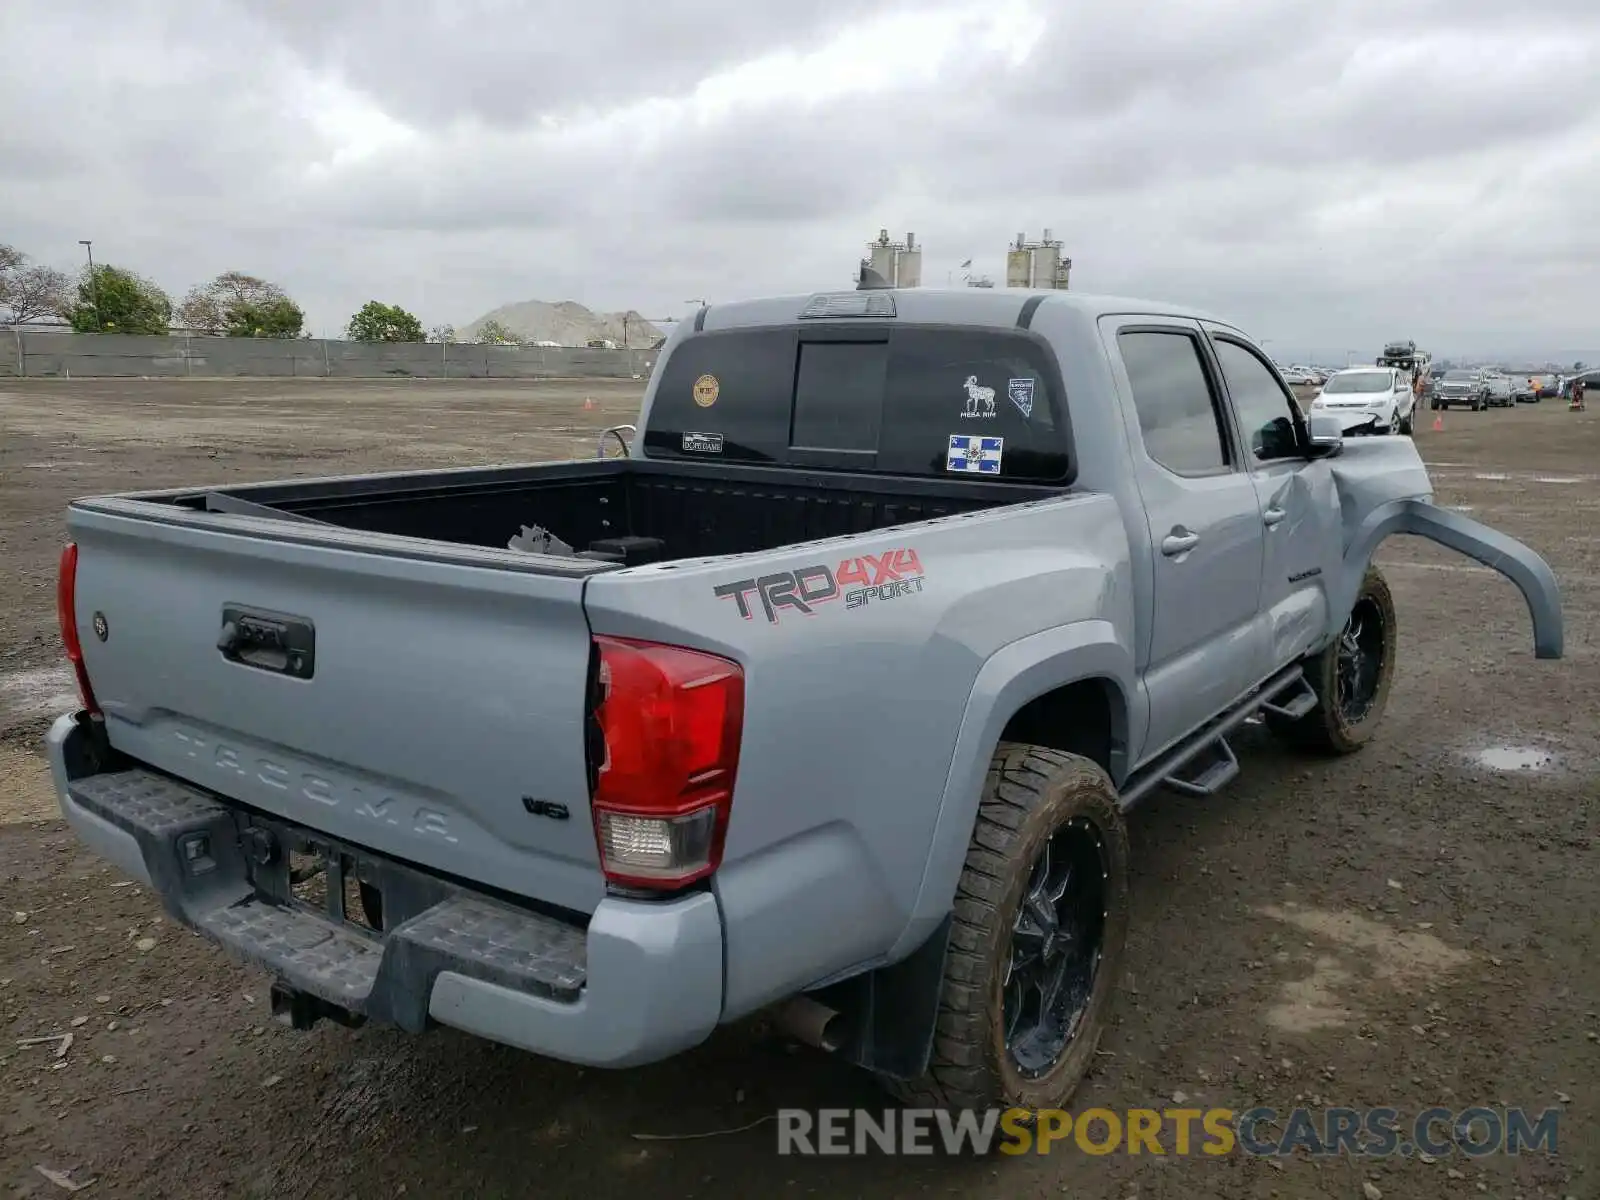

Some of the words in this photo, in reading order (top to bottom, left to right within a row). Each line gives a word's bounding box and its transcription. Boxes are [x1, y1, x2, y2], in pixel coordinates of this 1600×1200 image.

[714, 564, 840, 625] TRD
[846, 576, 926, 610] SPORT
[174, 731, 459, 843] TACOMA
[521, 796, 570, 820] V6
